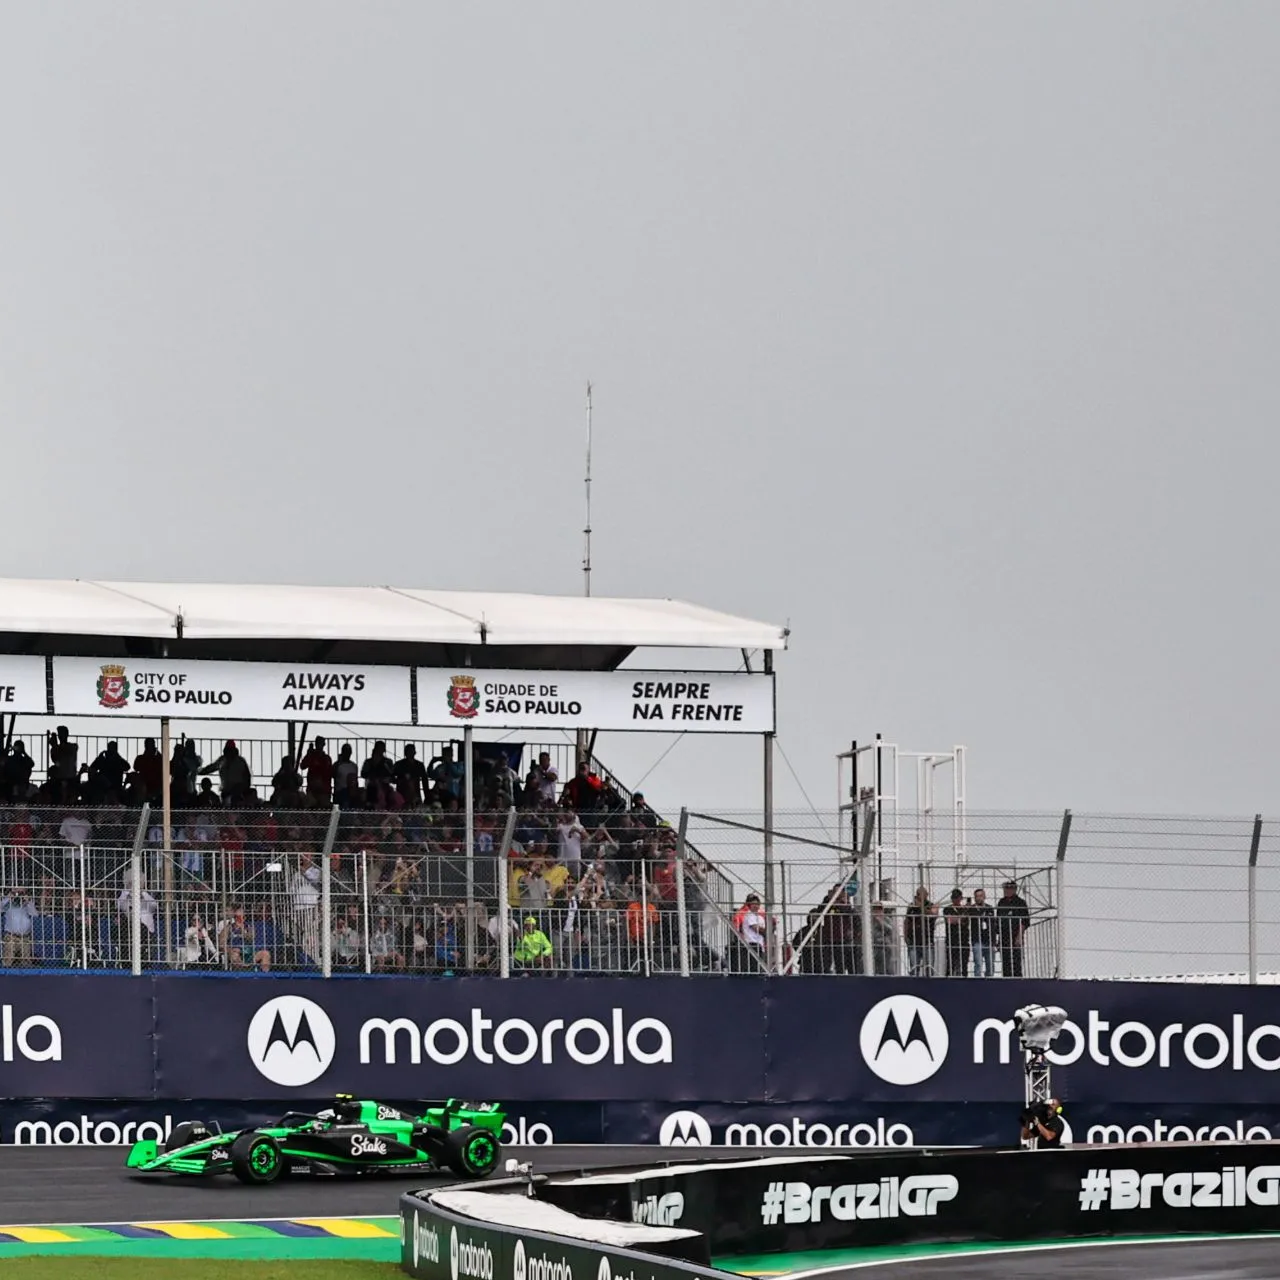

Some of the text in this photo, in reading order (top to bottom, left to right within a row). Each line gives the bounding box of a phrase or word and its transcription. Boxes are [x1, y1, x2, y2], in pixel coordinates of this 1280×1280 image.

[135, 673, 186, 685] CITY OF
[283, 673, 364, 690] ALWAYS
[135, 686, 232, 704] SÃO PAULO
[485, 684, 557, 696] CIDADE DE
[632, 682, 710, 699] SEMPRE
[283, 695, 354, 711] AHEAD
[486, 696, 581, 715] SÃO PAULO
[633, 704, 742, 721] NA FRENTE
[360, 1008, 673, 1064] motorola
[378, 1106, 400, 1120] Stake
[15, 1115, 189, 1144] motorol
[725, 1117, 914, 1147] motorola
[351, 1134, 387, 1156] Stake
[1078, 1165, 1280, 1211] #BrazilG
[761, 1175, 958, 1224] #BrazilGP
[460, 1239, 492, 1280] motorola
